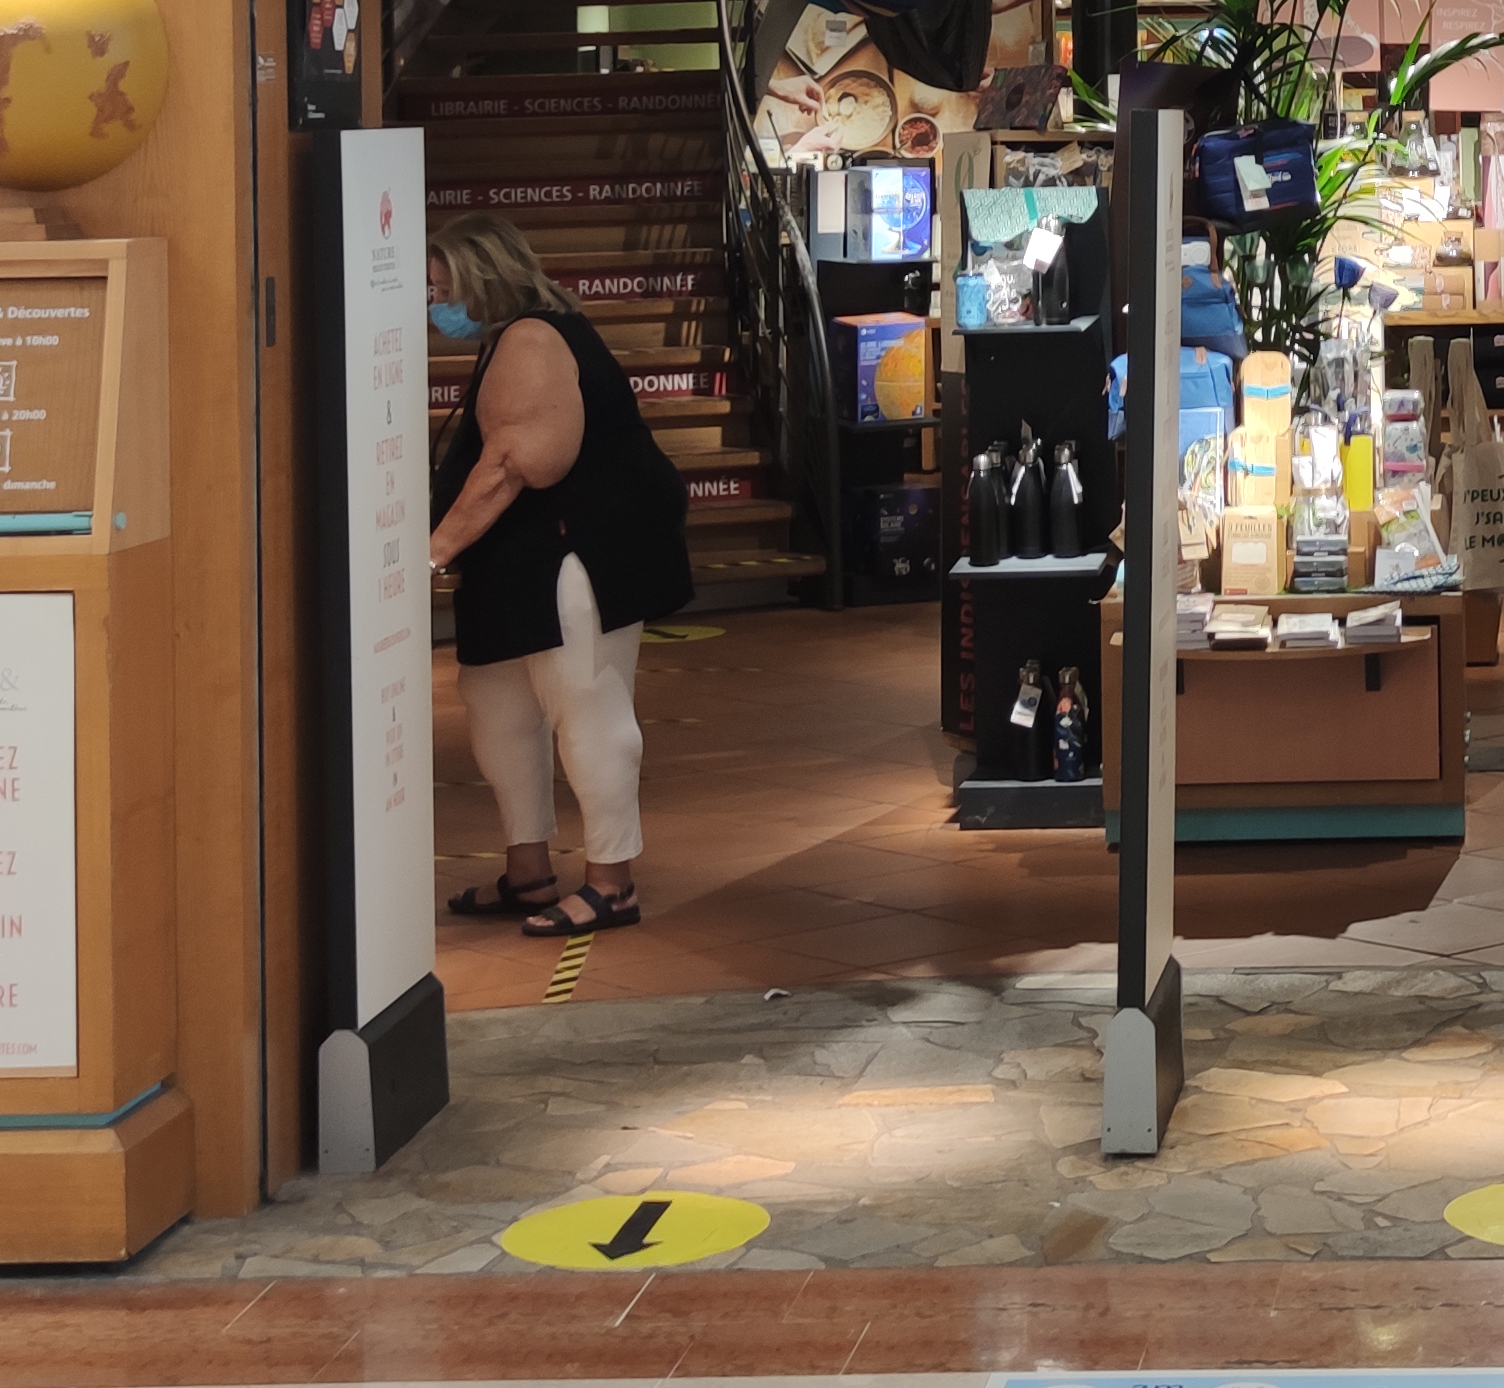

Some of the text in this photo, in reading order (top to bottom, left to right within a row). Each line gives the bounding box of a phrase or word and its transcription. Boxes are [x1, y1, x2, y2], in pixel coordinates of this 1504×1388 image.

[1436, 7, 1478, 18] INSPIREZ
[1442, 21, 1486, 30] RESPIREZ
[430, 96, 602, 117] LIBRAIRIE SCIENCES
[489, 179, 703, 205] SCIENCES RANDONNÉE
[578, 271, 696, 296] RANDONNÉE
[8, 305, 90, 319] Découvertes
[15, 335, 23, 347] à
[25, 335, 59, 347] 10h00
[2, 410, 10, 421] à
[12, 409, 46, 421] 20h00
[3, 479, 56, 490] dimanche
